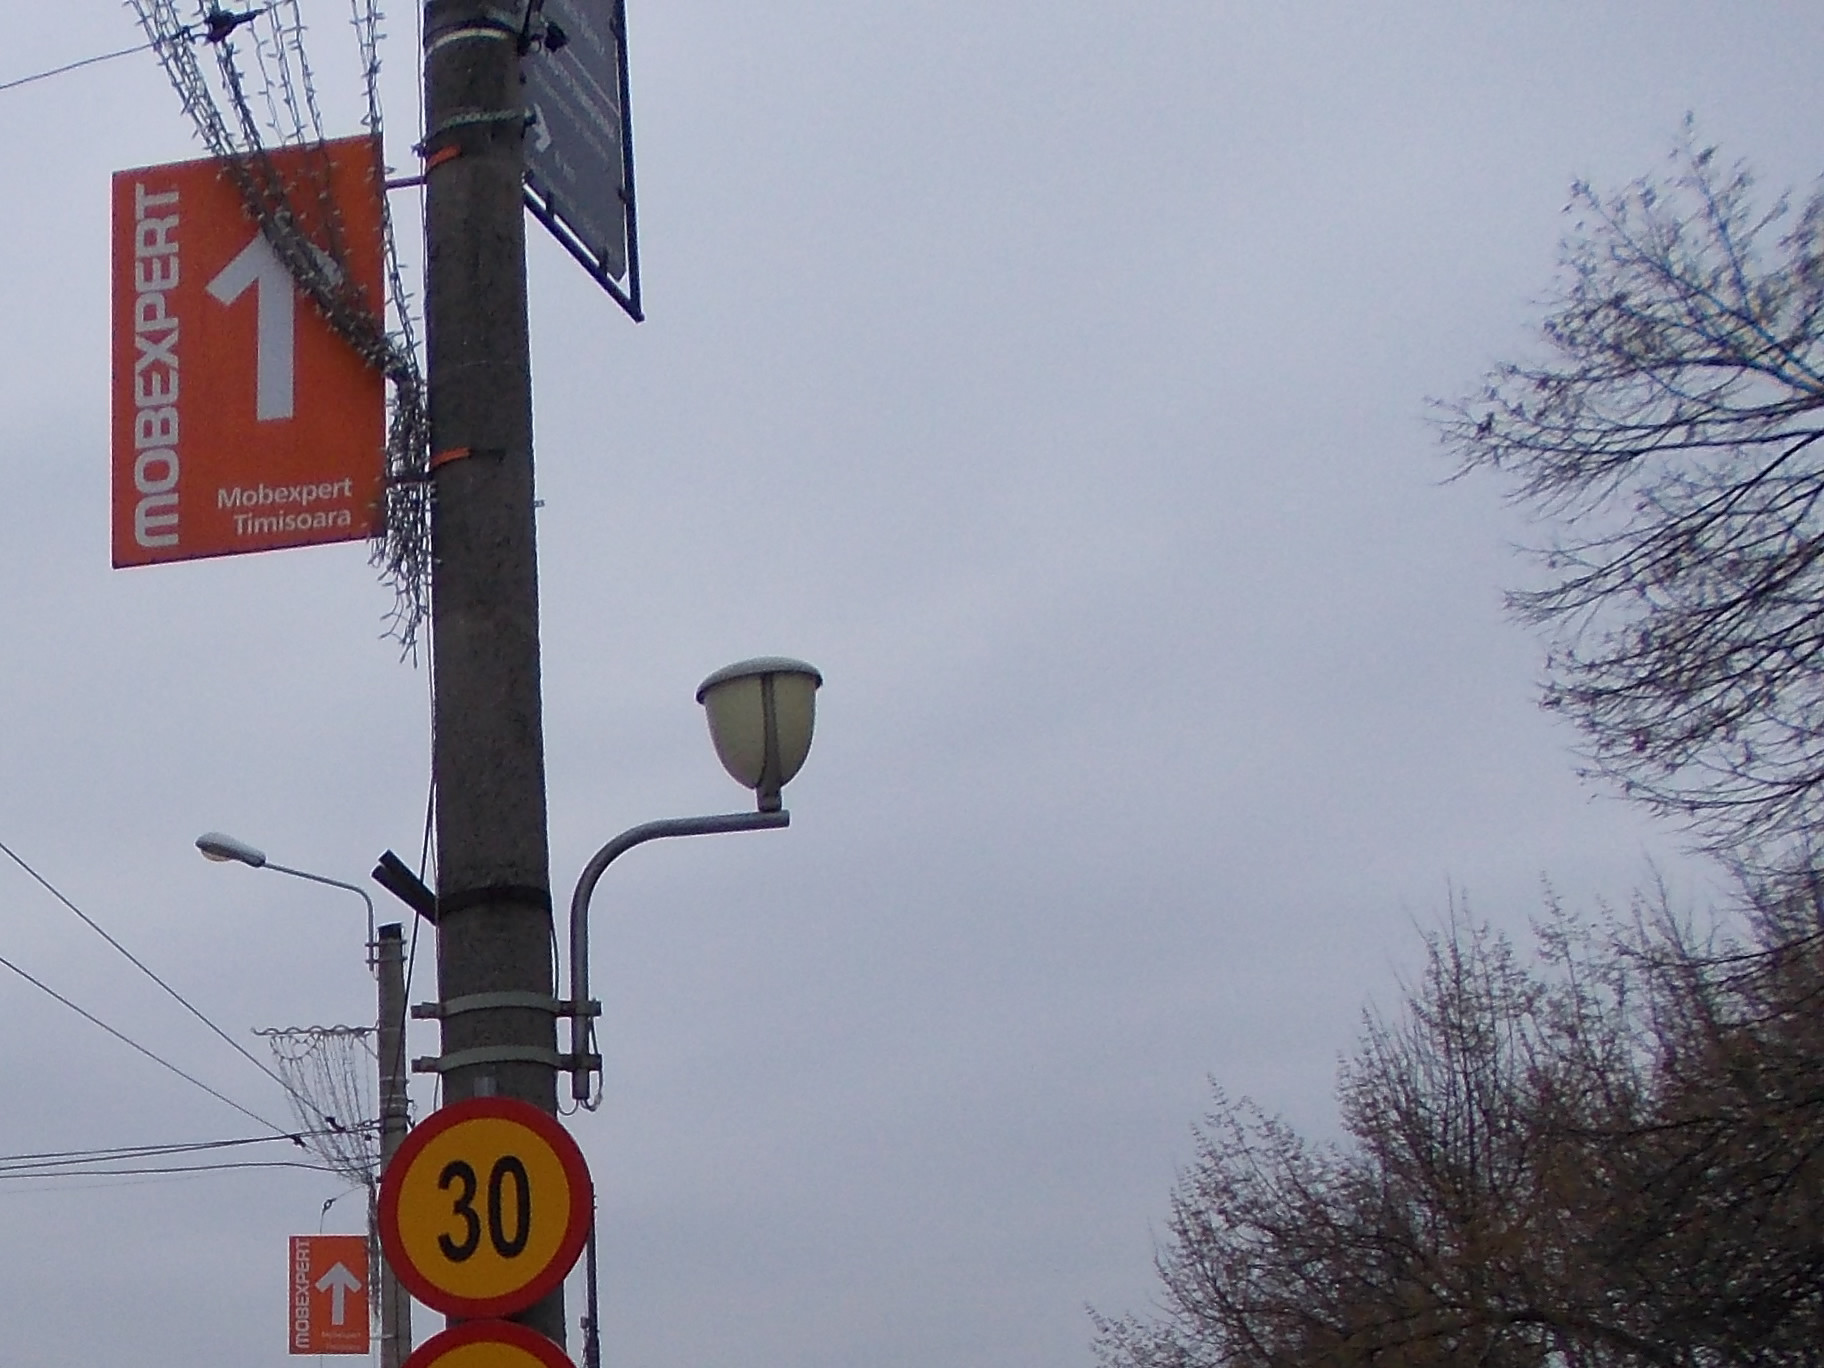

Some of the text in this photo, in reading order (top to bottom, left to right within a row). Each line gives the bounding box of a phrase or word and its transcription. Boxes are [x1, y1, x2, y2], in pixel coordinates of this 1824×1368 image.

[134, 182, 180, 548] MOBEXPERT
[217, 477, 353, 510] Mobexpert
[234, 509, 352, 536] Timisoara
[437, 1155, 531, 1263] 30
[295, 1238, 310, 1349] MOBEXPERT
